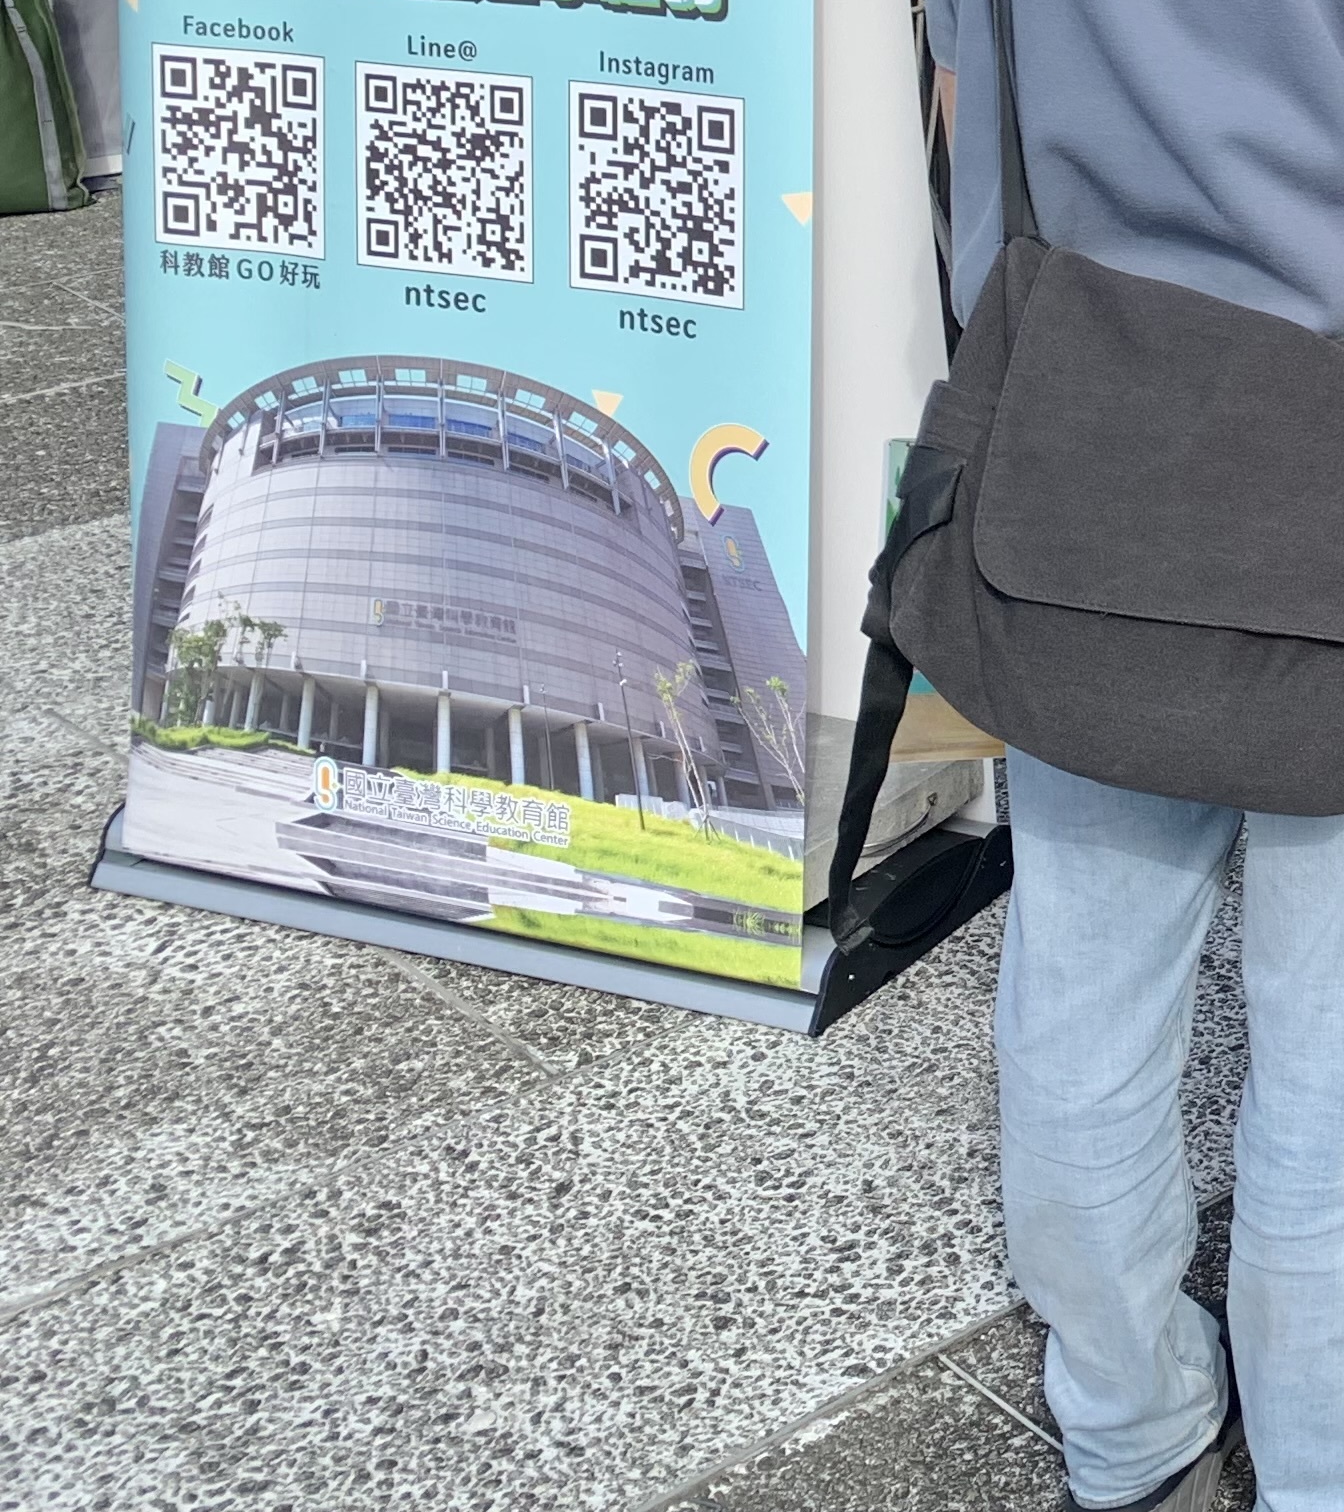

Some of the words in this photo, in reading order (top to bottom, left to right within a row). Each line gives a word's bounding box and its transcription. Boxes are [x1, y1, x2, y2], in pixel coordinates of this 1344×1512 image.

[183, 15, 295, 44] Facebook
[406, 35, 478, 61] Line@
[598, 50, 715, 85] Instagram
[405, 283, 487, 315] ntsec
[618, 305, 698, 341] ntsec
[344, 769, 570, 832] 國立臺灣科學教育館
[344, 798, 388, 816] National
[391, 806, 428, 824] Taiwan
[432, 813, 472, 831] Science
[476, 821, 529, 840] Education
[533, 831, 569, 847] Center
